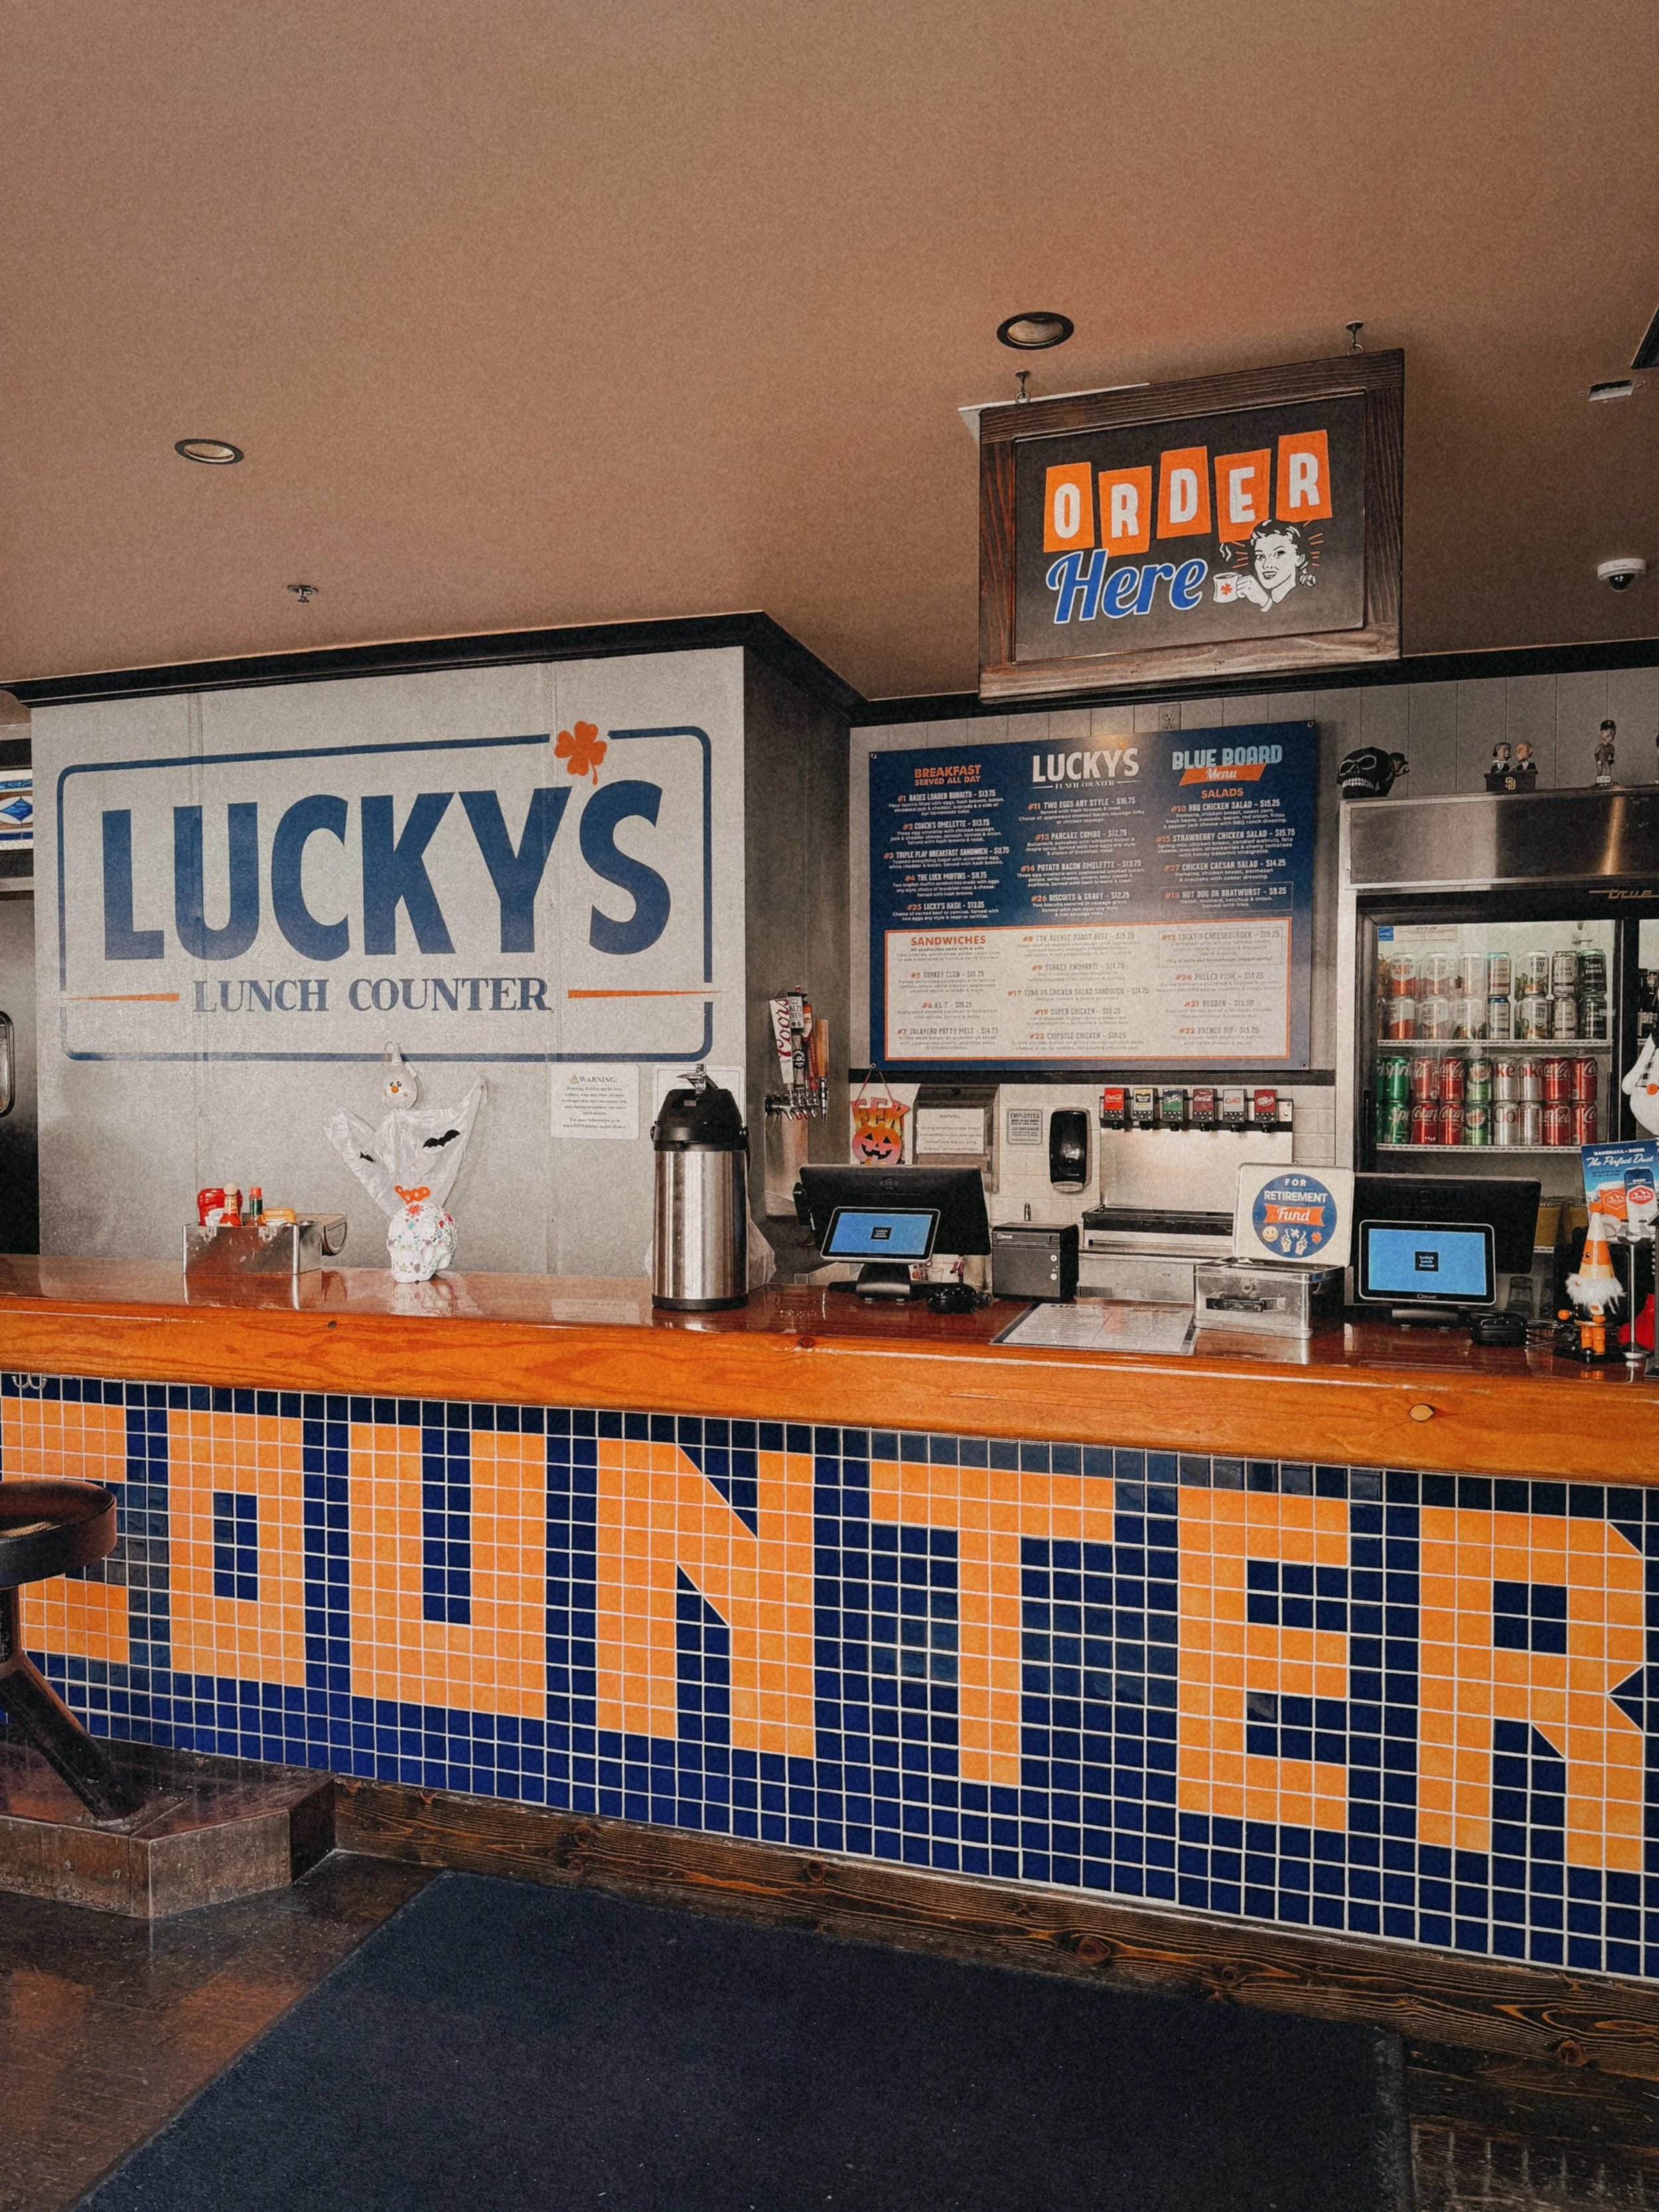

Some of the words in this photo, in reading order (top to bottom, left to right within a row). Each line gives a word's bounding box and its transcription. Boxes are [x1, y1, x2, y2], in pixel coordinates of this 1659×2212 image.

[1053, 452, 1319, 539] ORDER
[1046, 548, 1209, 625] Here
[1172, 749, 1216, 770] BLUE
[1222, 745, 1282, 767] BOARD
[914, 765, 981, 778] BREAKFAST
[1206, 769, 1237, 780] Menu
[927, 792, 947, 800] LOADED
[1201, 788, 1244, 798] SALADS
[1173, 832, 1215, 842] STRAWBERRY
[1222, 888, 1261, 897] BRATWURST
[1609, 889, 1652, 899] true
[911, 936, 985, 946] SANDWICHES
[193, 980, 328, 1013] LUNCH
[348, 977, 552, 1013] COUNTER
[1586, 1157, 1601, 1167] The
[1603, 1156, 1632, 1167] Perfect
[1264, 1191, 1328, 1203] RETIREMENT
[1277, 1208, 1310, 1221] Fund
